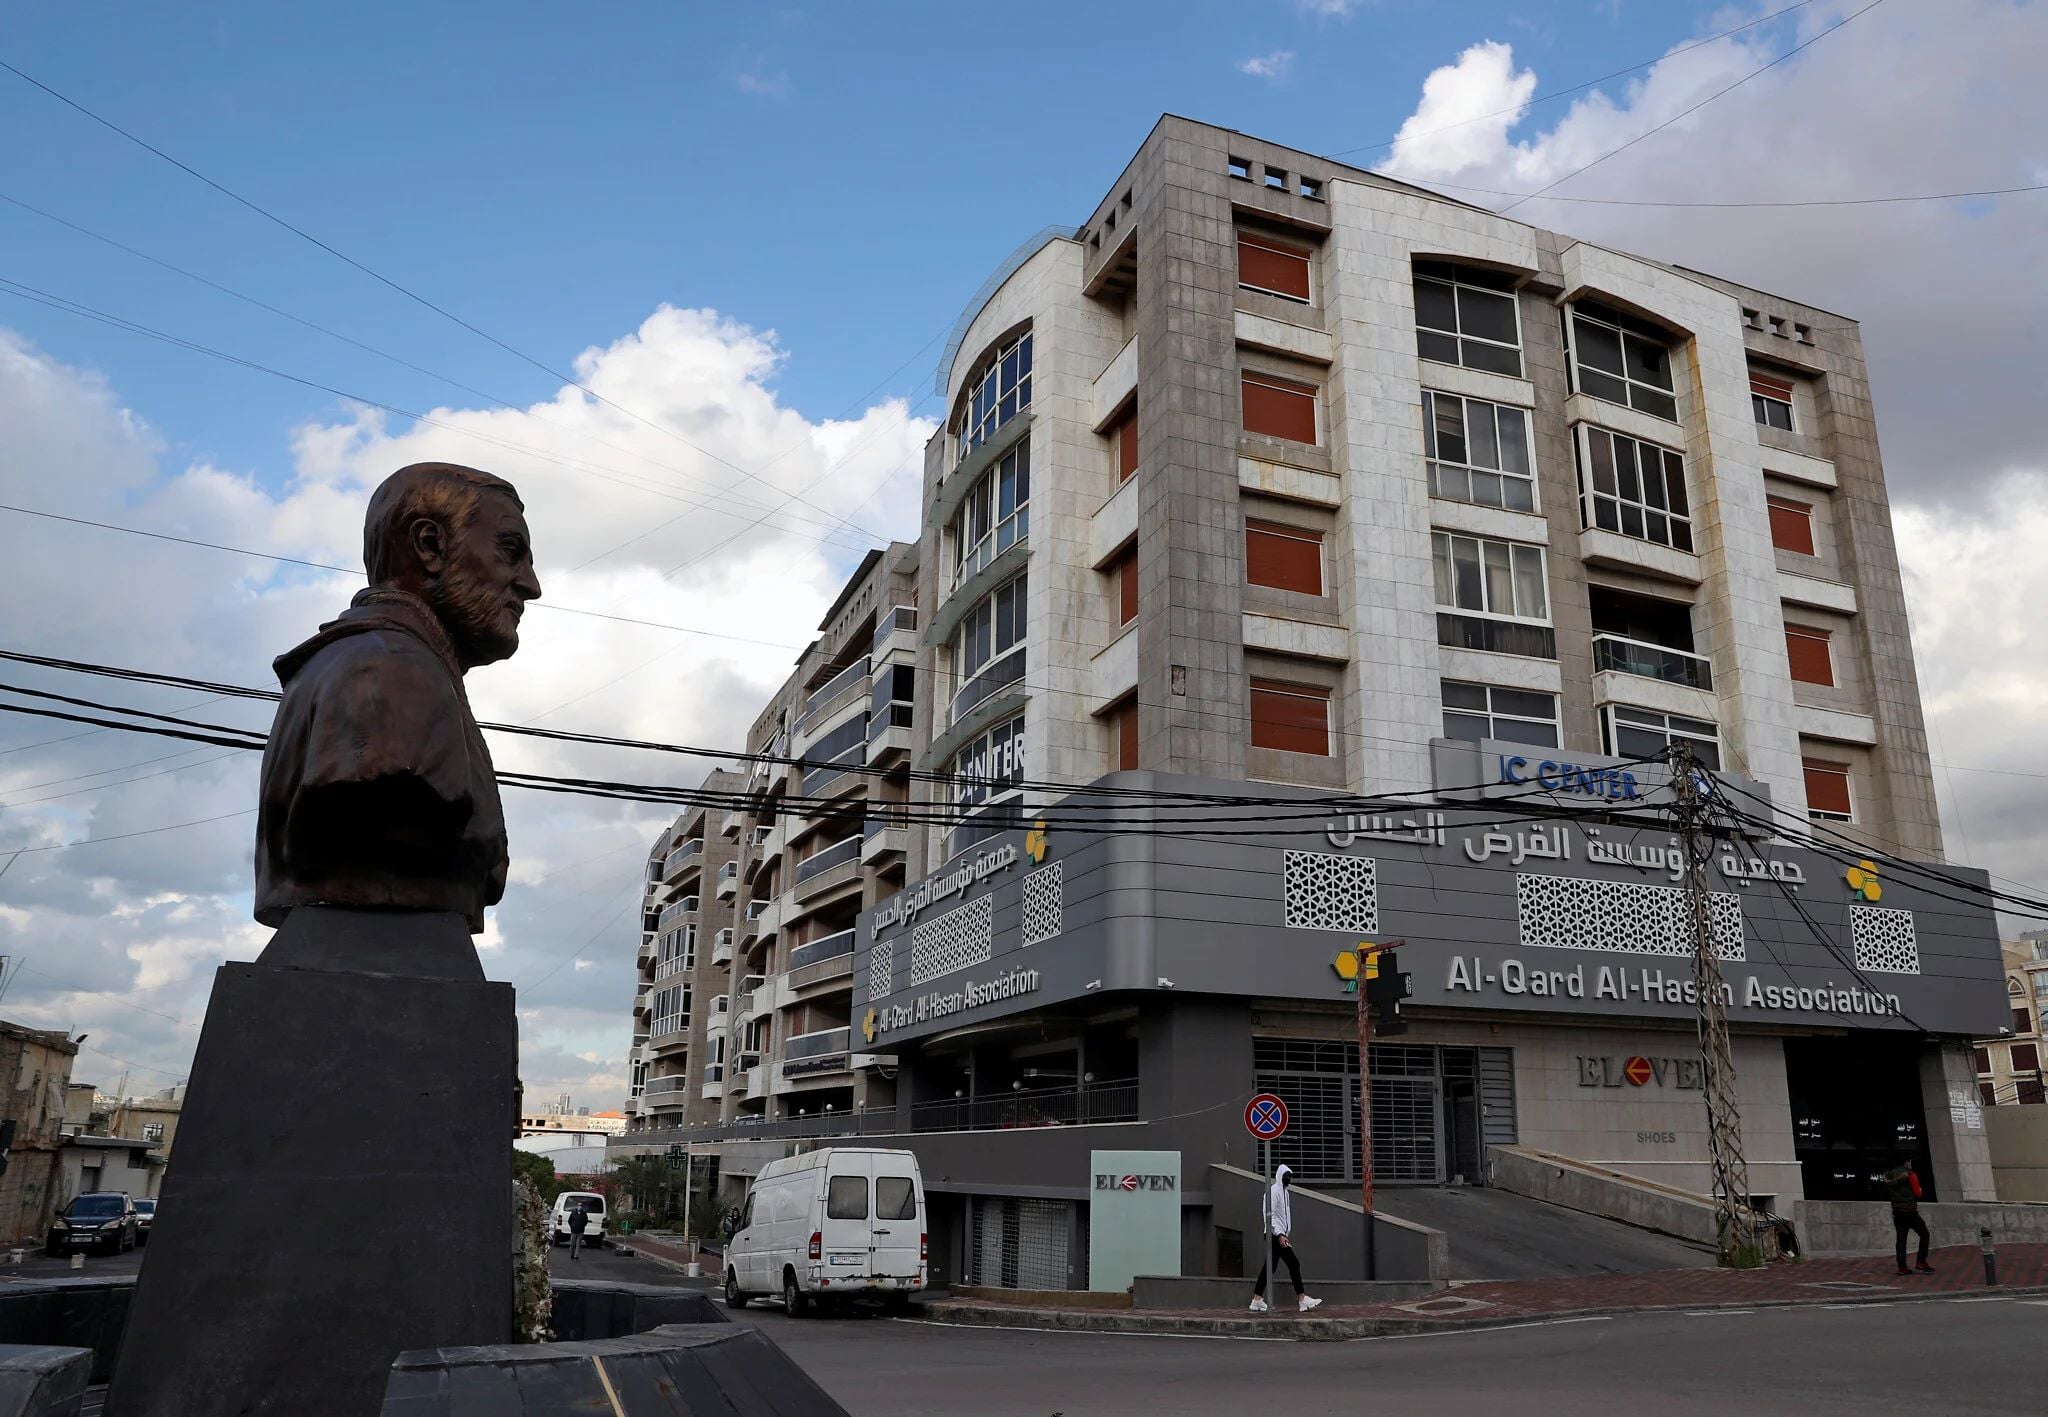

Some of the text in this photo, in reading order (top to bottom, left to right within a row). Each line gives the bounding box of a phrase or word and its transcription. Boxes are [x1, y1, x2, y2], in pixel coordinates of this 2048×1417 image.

[1499, 754, 1638, 801] IC CENTER
[1327, 806, 1808, 892] جمعية ؤسسة القرض الحسن
[871, 843, 1019, 941] جمعية مؤسسة القرض الحسن
[879, 965, 1040, 1033] Al-Qard Al-Hasan Association
[1445, 955, 1585, 999] Al-Qard
[1743, 975, 1902, 1017] Association
[1637, 1131, 1676, 1144] SHOES
